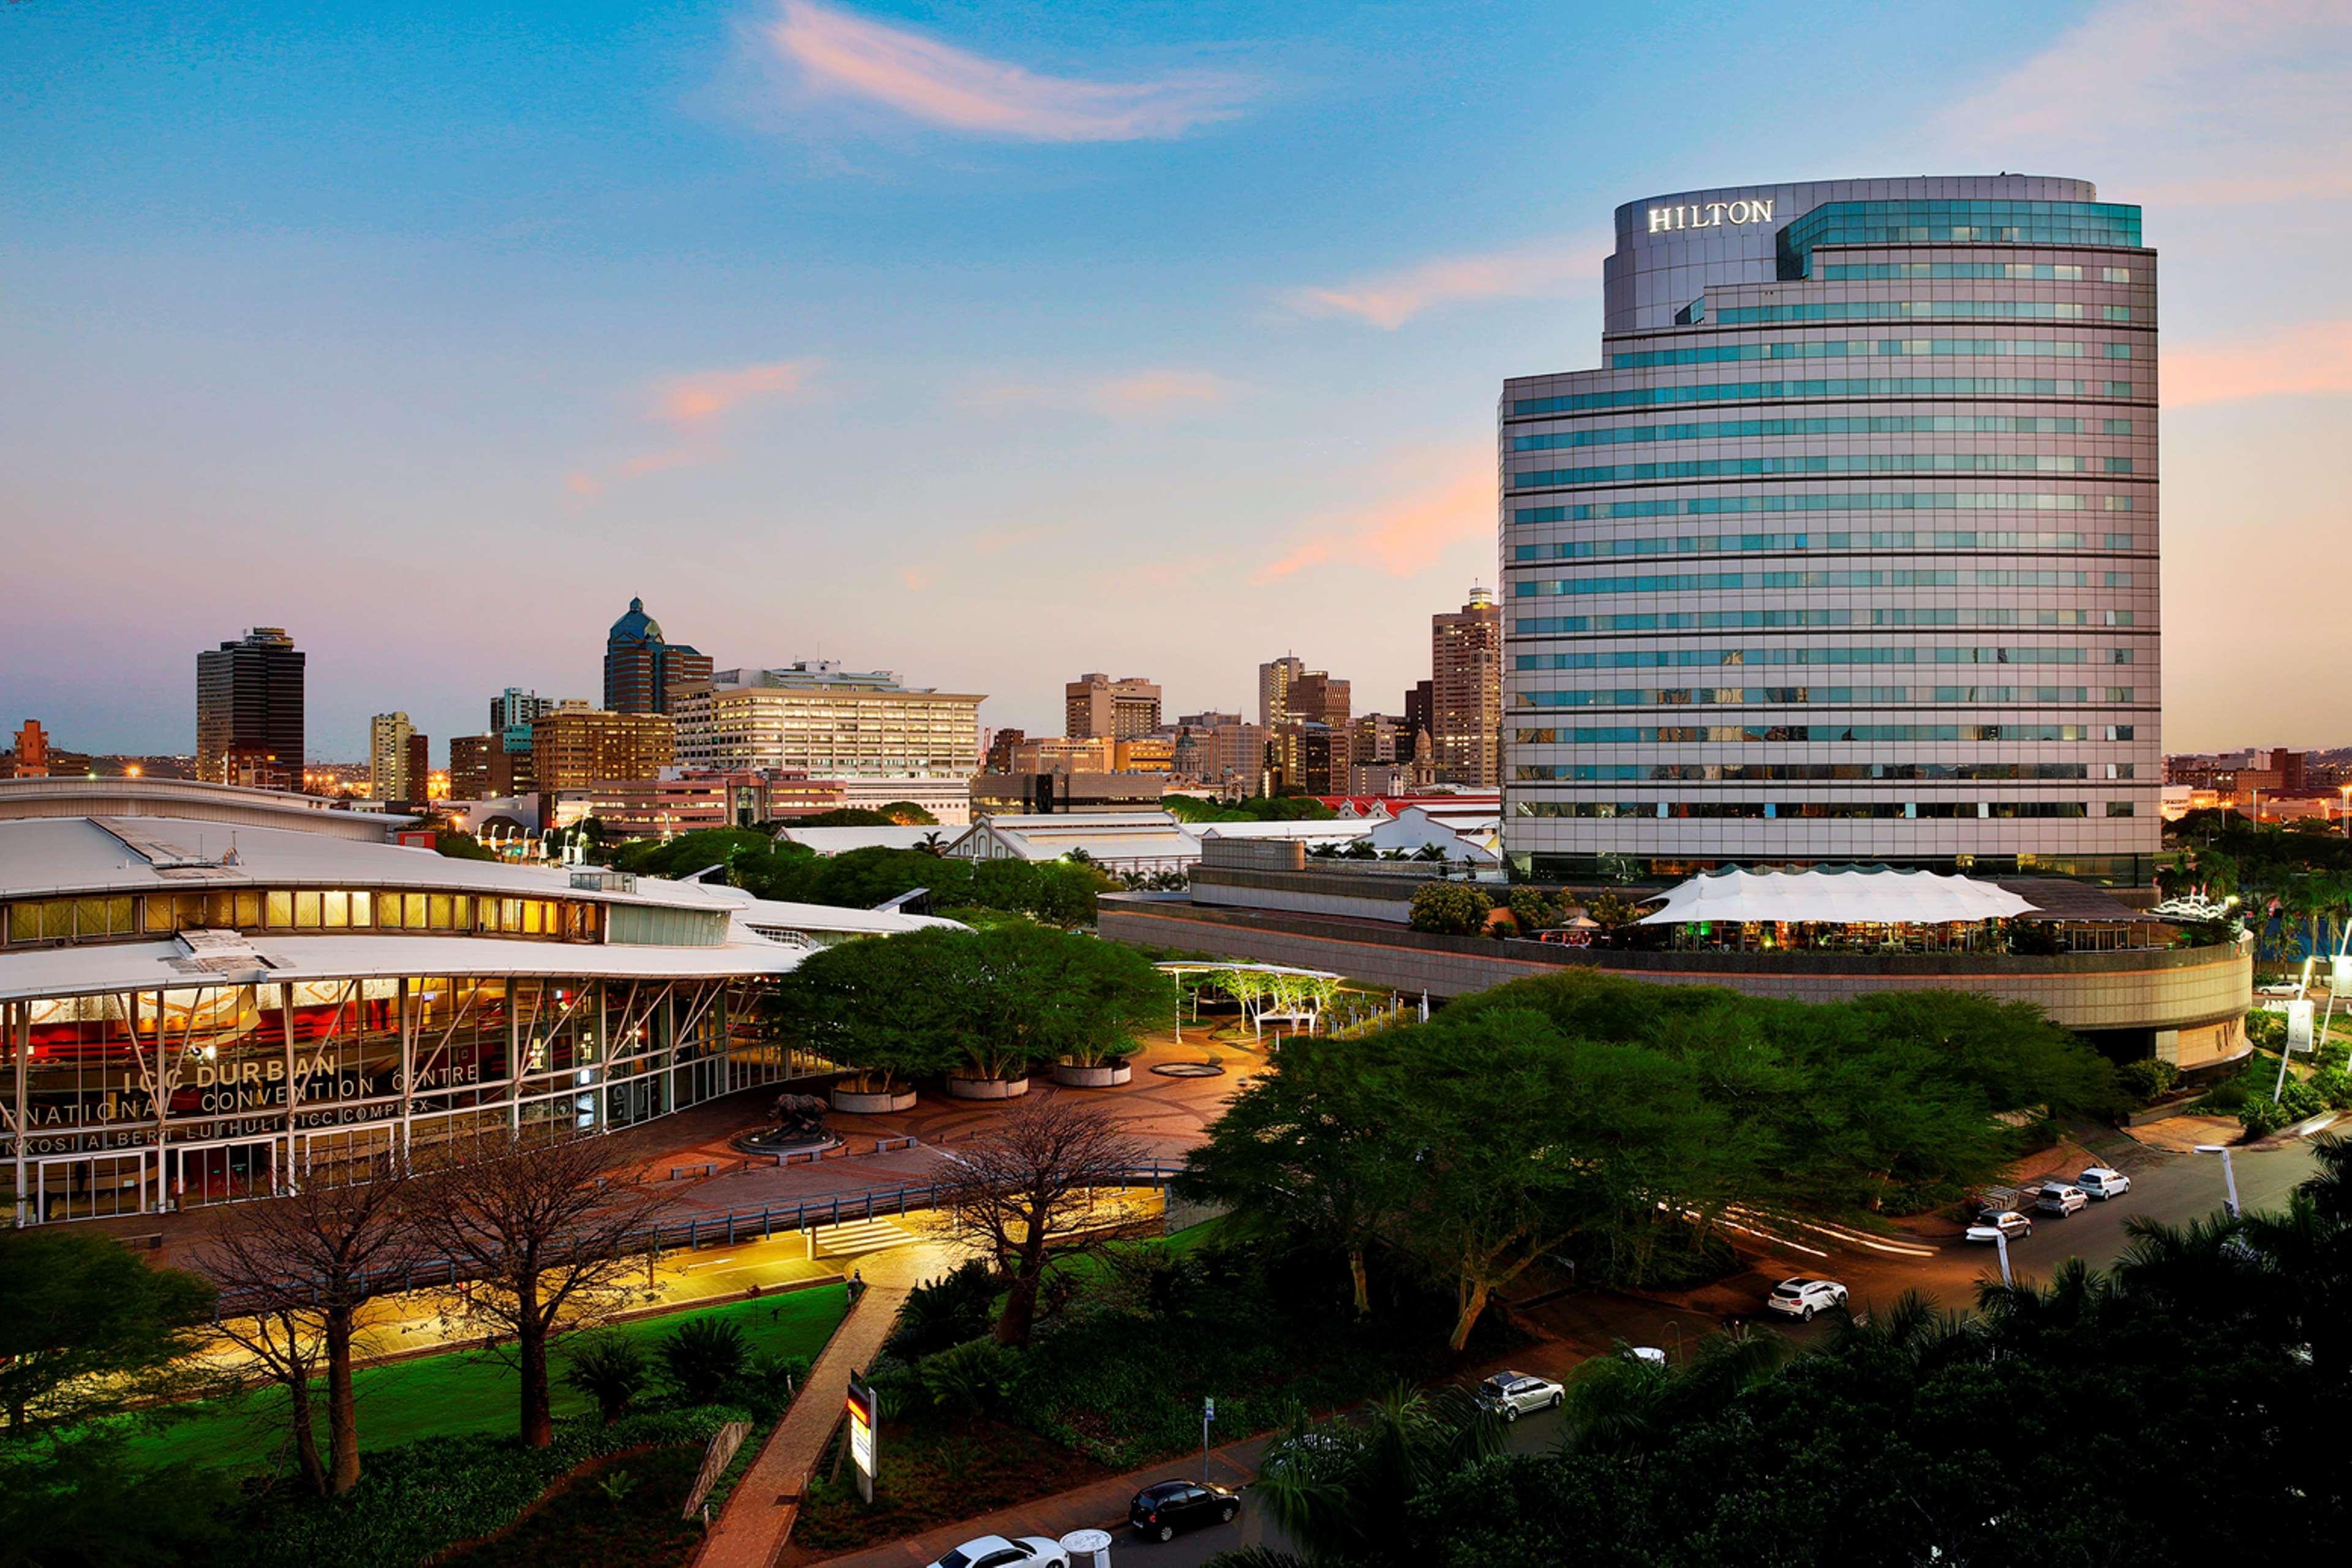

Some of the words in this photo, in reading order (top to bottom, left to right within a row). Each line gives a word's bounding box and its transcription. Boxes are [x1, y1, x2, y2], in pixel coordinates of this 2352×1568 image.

[1648, 200, 1774, 233] HILTON
[124, 1069, 183, 1094] ICC
[197, 1055, 335, 1088] DURBAN
[202, 1077, 373, 1112] CONVENTION
[186, 1117, 277, 1139] LUTHULI
[301, 1112, 333, 1127] ICC
[344, 1099, 428, 1122] COMPLEX
